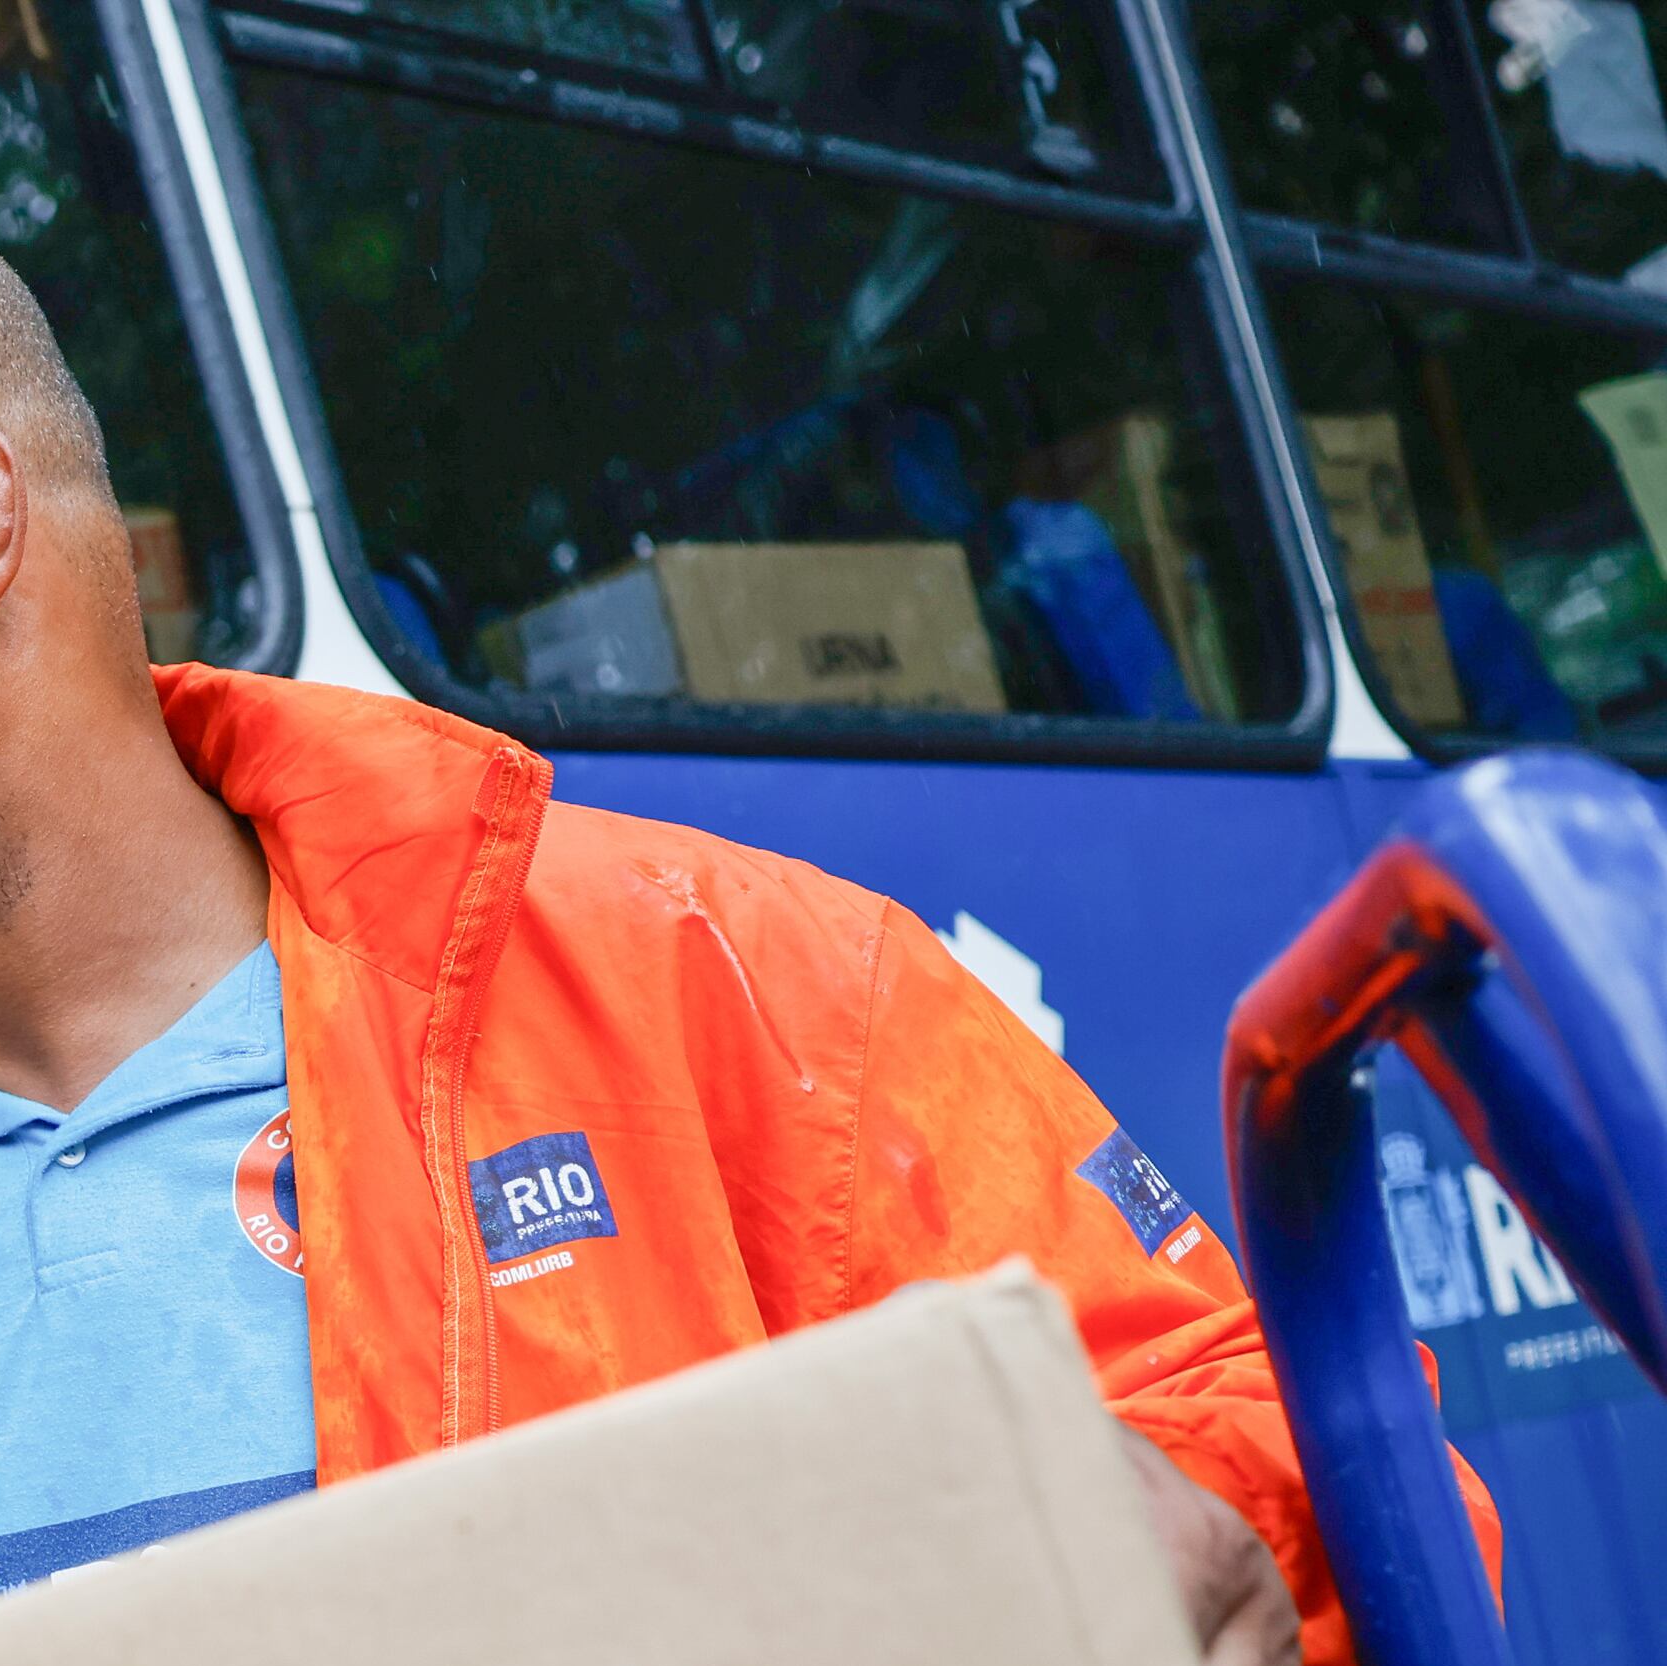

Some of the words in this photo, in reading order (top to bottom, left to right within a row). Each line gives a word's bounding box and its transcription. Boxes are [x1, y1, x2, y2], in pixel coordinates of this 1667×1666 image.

[501, 1162, 596, 1225] RIO
[245, 1213, 289, 1255] RIO
[489, 1251, 575, 1288] COMLURB
